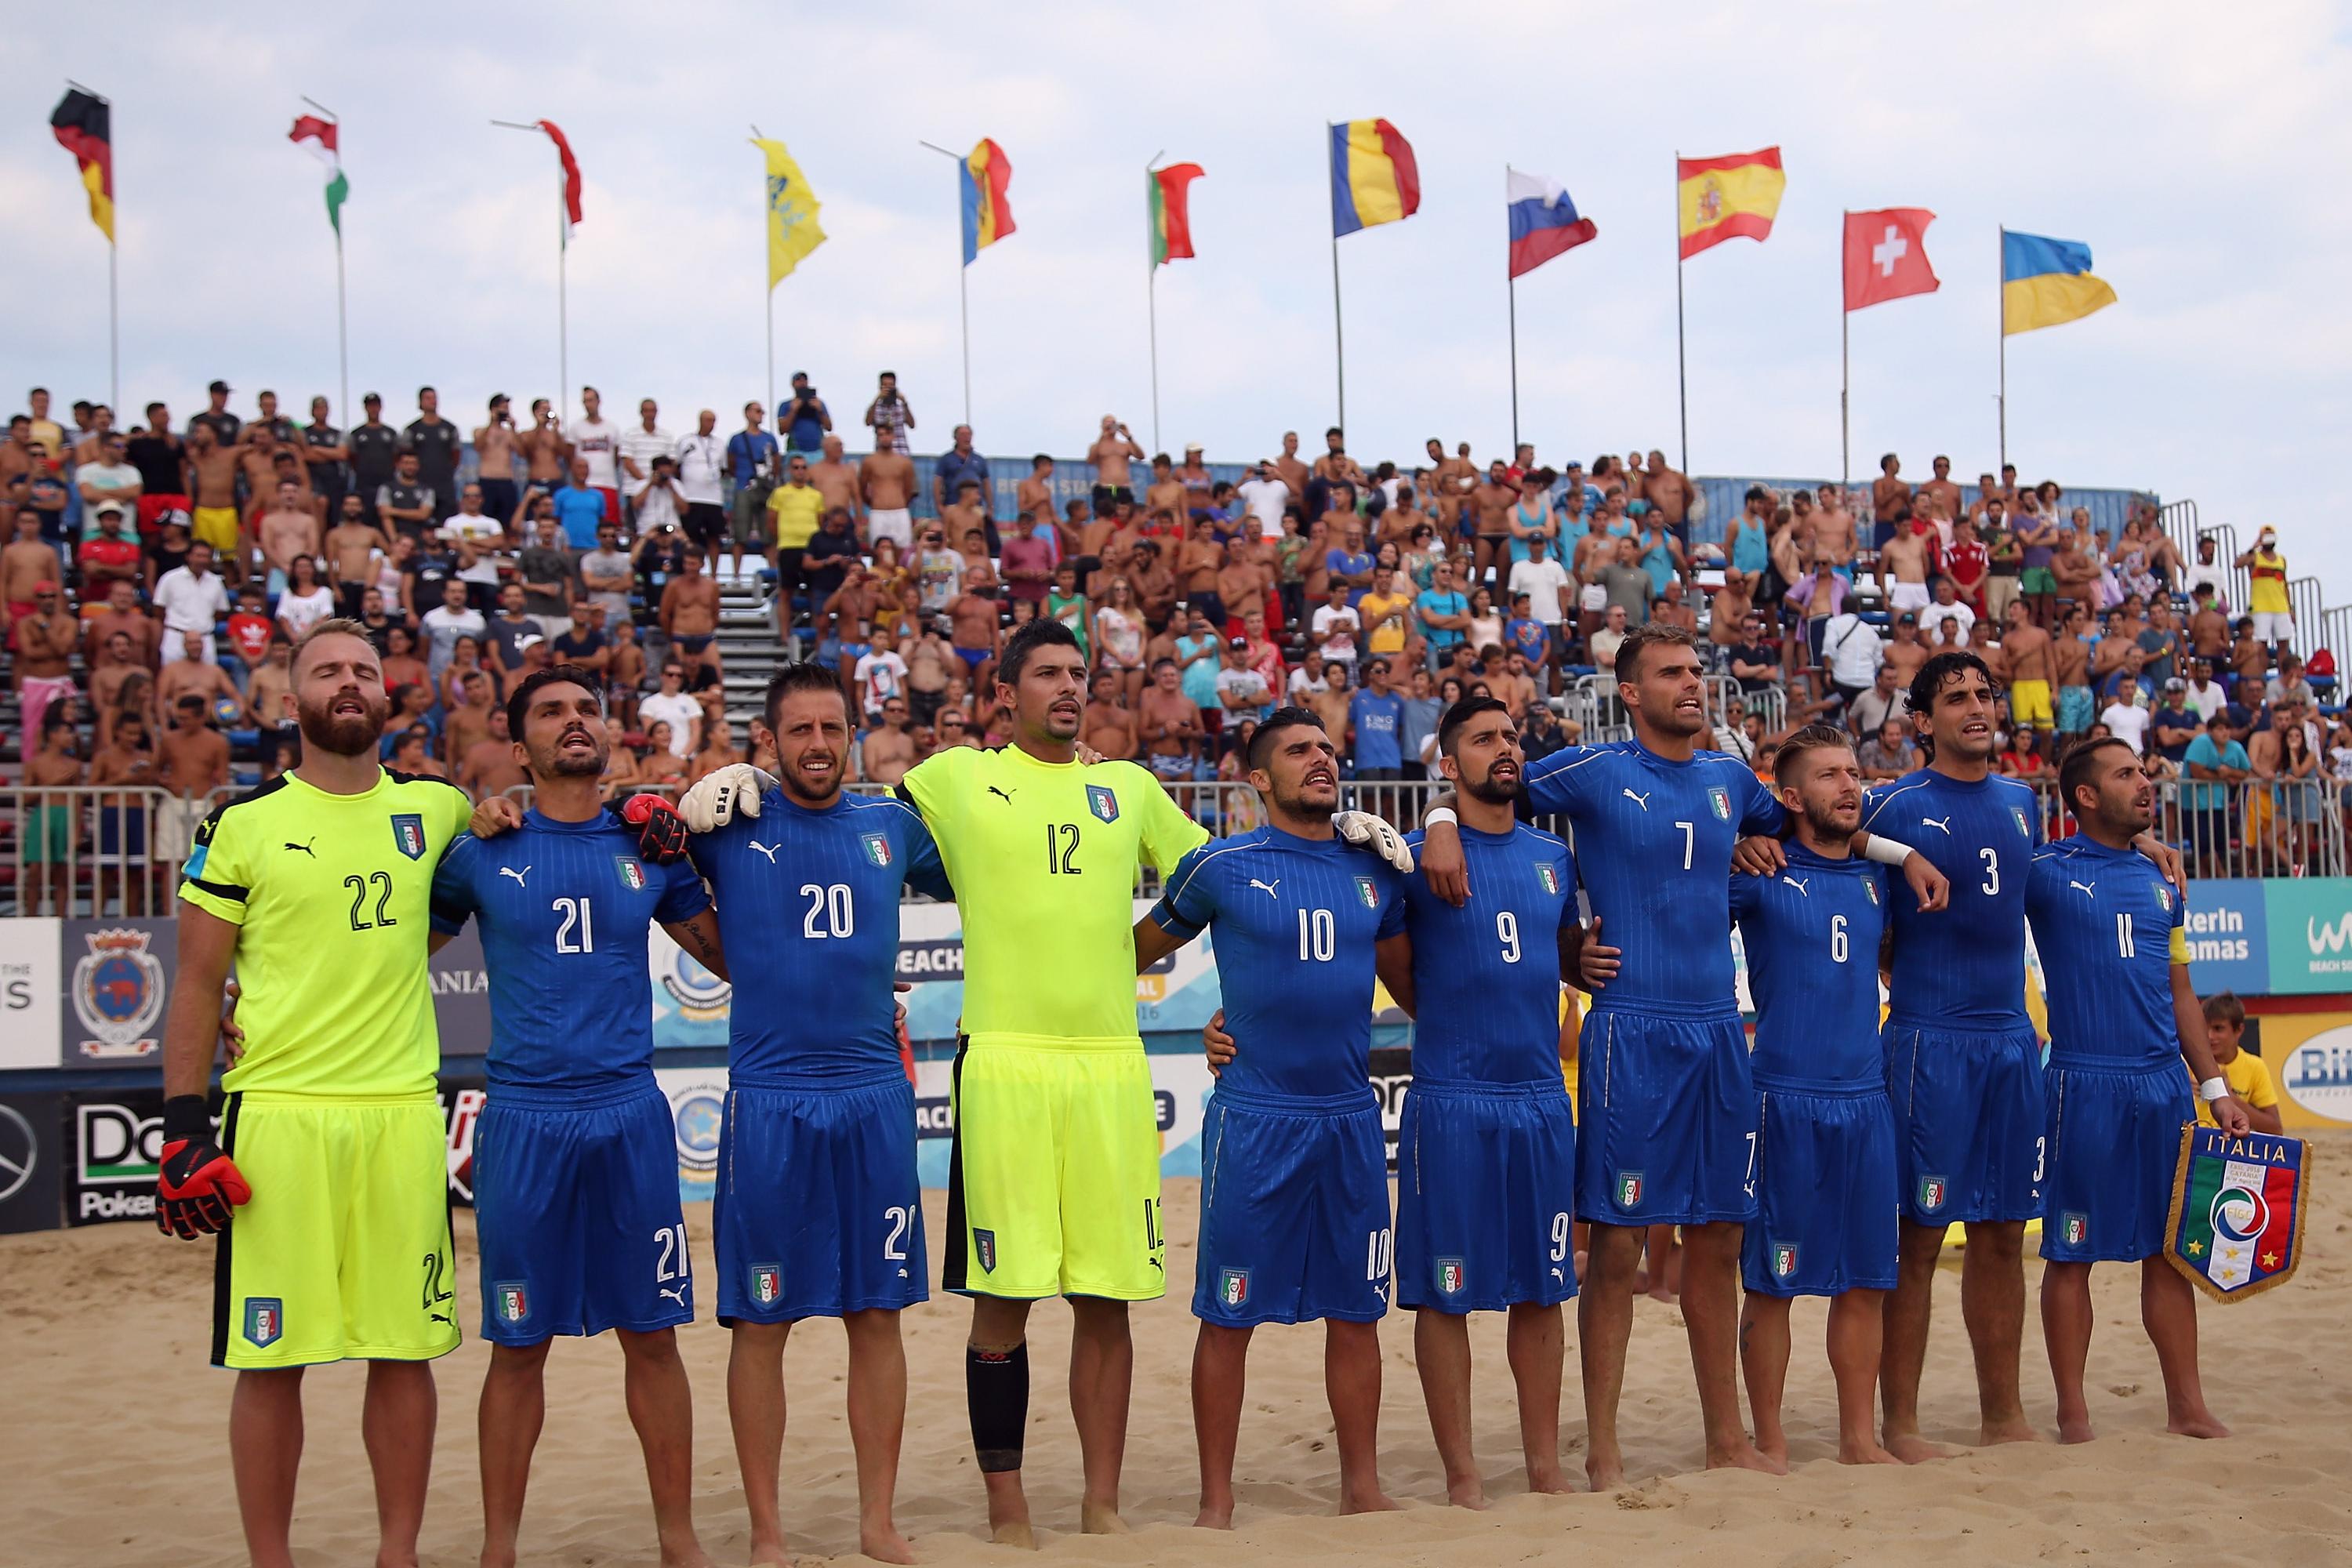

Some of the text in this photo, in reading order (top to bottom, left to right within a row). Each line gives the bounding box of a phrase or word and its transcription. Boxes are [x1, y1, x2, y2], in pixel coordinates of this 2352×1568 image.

[1366, 714, 1393, 724] KING
[1047, 824, 1082, 875] 12
[1675, 822, 1693, 869] 7
[1980, 848, 1999, 895] 3
[344, 871, 397, 931] 22
[552, 898, 593, 953] 21
[800, 884, 854, 938] 20
[1298, 909, 1334, 962] 10
[1496, 911, 1521, 964] 9
[1831, 915, 1848, 963] 6
[2117, 913, 2135, 958] 11
[428, 971, 488, 993] ANIA
[895, 947, 964, 974] EACH
[1746, 1131, 1756, 1180] 7
[2033, 1136, 2045, 1182] 3
[2207, 1134, 2286, 1163] ITALIA
[654, 1222, 687, 1283] 21
[1367, 1228, 1391, 1281] 10
[1550, 1212, 1569, 1261] 9
